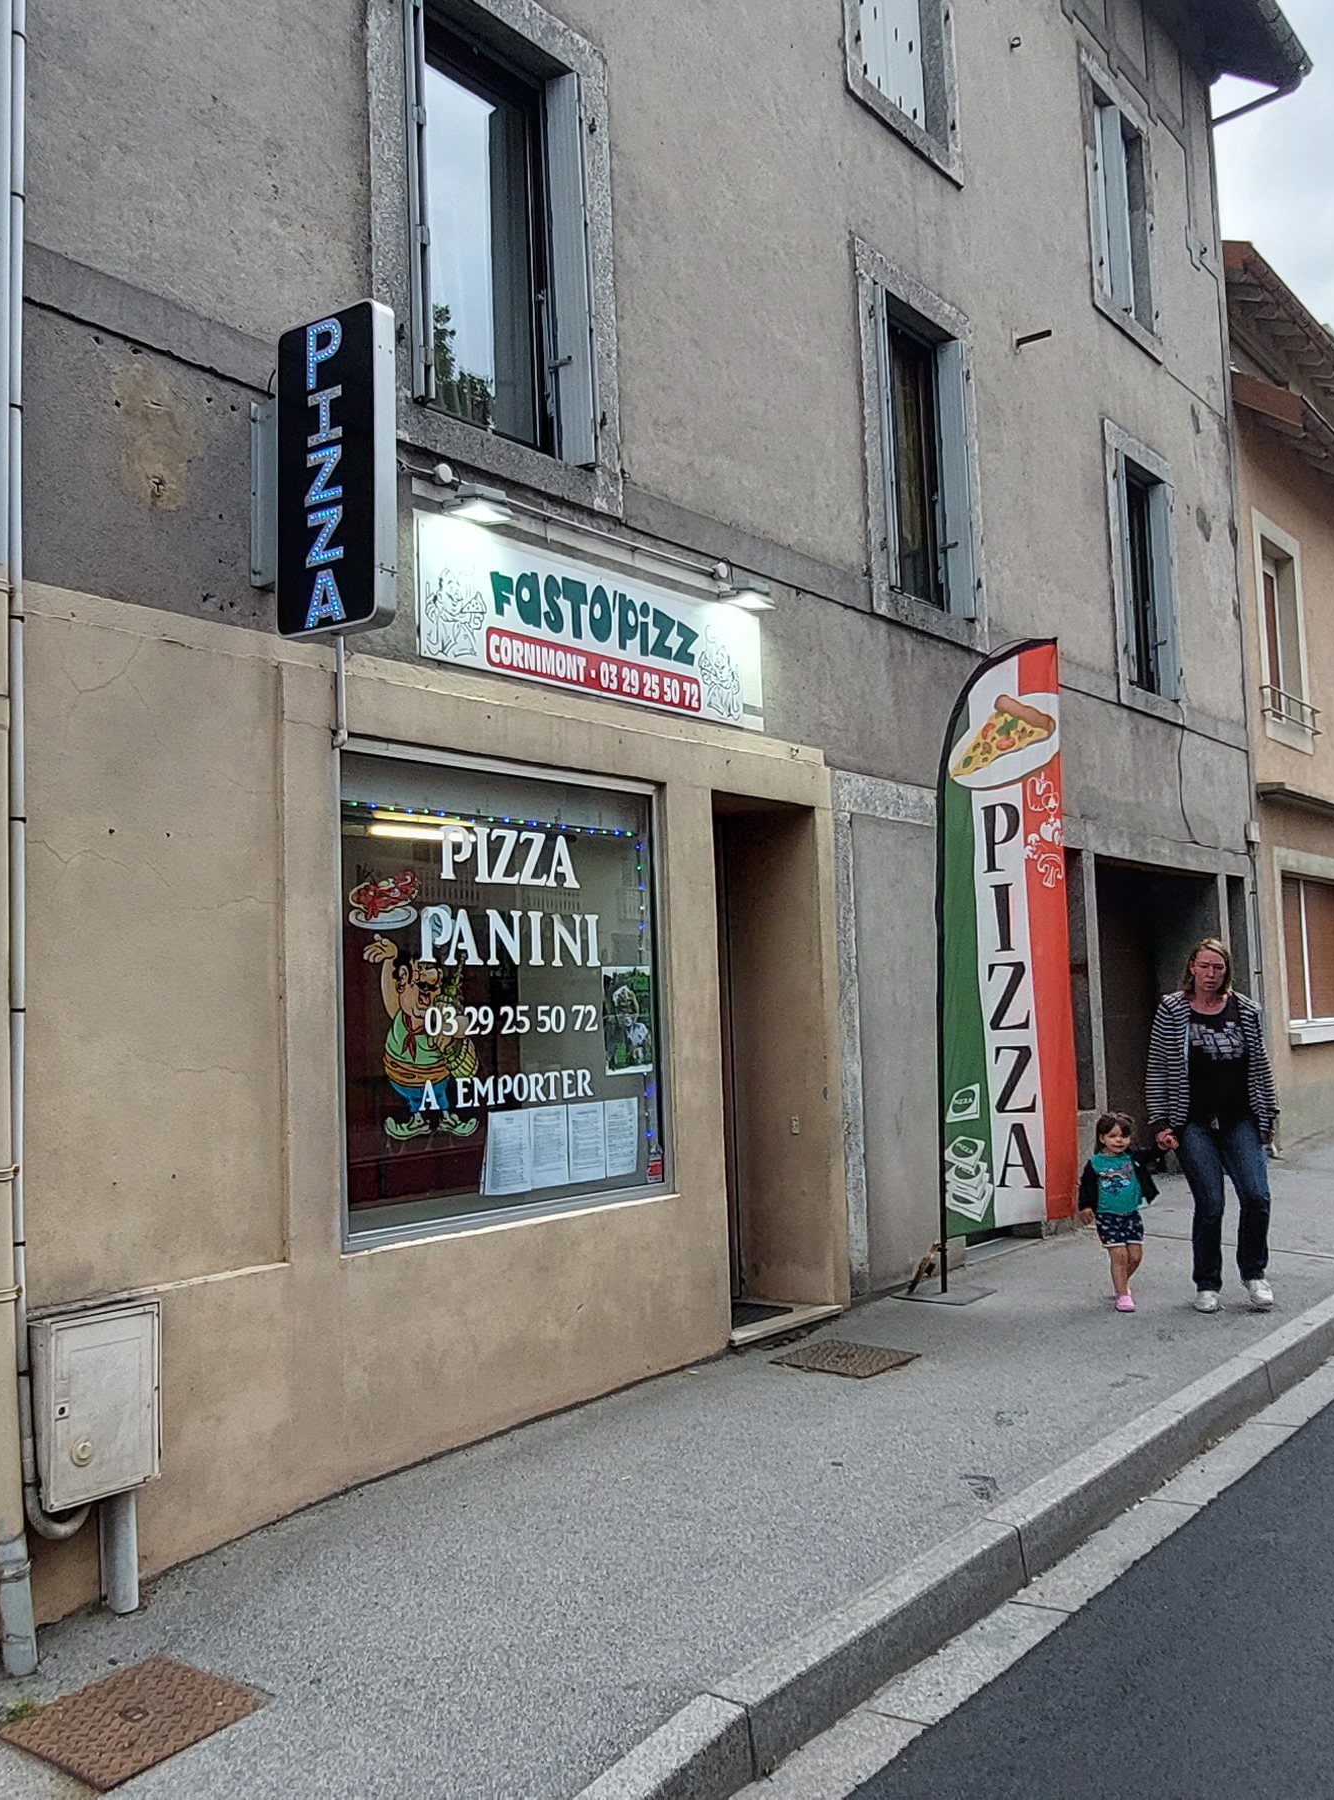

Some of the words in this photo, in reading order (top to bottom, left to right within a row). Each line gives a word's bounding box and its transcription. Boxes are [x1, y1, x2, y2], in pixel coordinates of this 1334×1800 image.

[304, 317, 346, 629] PIZZA
[489, 633, 586, 683] CORNIMONT
[600, 662, 618, 690] 03
[621, 667, 640, 695] 29
[643, 672, 660, 700] 25
[663, 677, 680, 704] 50
[683, 682, 699, 708] 72
[440, 825, 580, 889] PIZZA
[418, 905, 601, 967] PANINI
[424, 1005, 459, 1036] 03
[463, 1005, 494, 1035] 29
[500, 1005, 531, 1034] 25
[537, 1005, 565, 1033] 50
[571, 1004, 598, 1032] 72
[980, 802, 1044, 1190] PIZZA
[418, 1079, 440, 1111] A
[455, 1069, 594, 1109] EMPORTER
[954, 1097, 973, 1105] PIZZA
[955, 1142, 974, 1155] PIZZA
